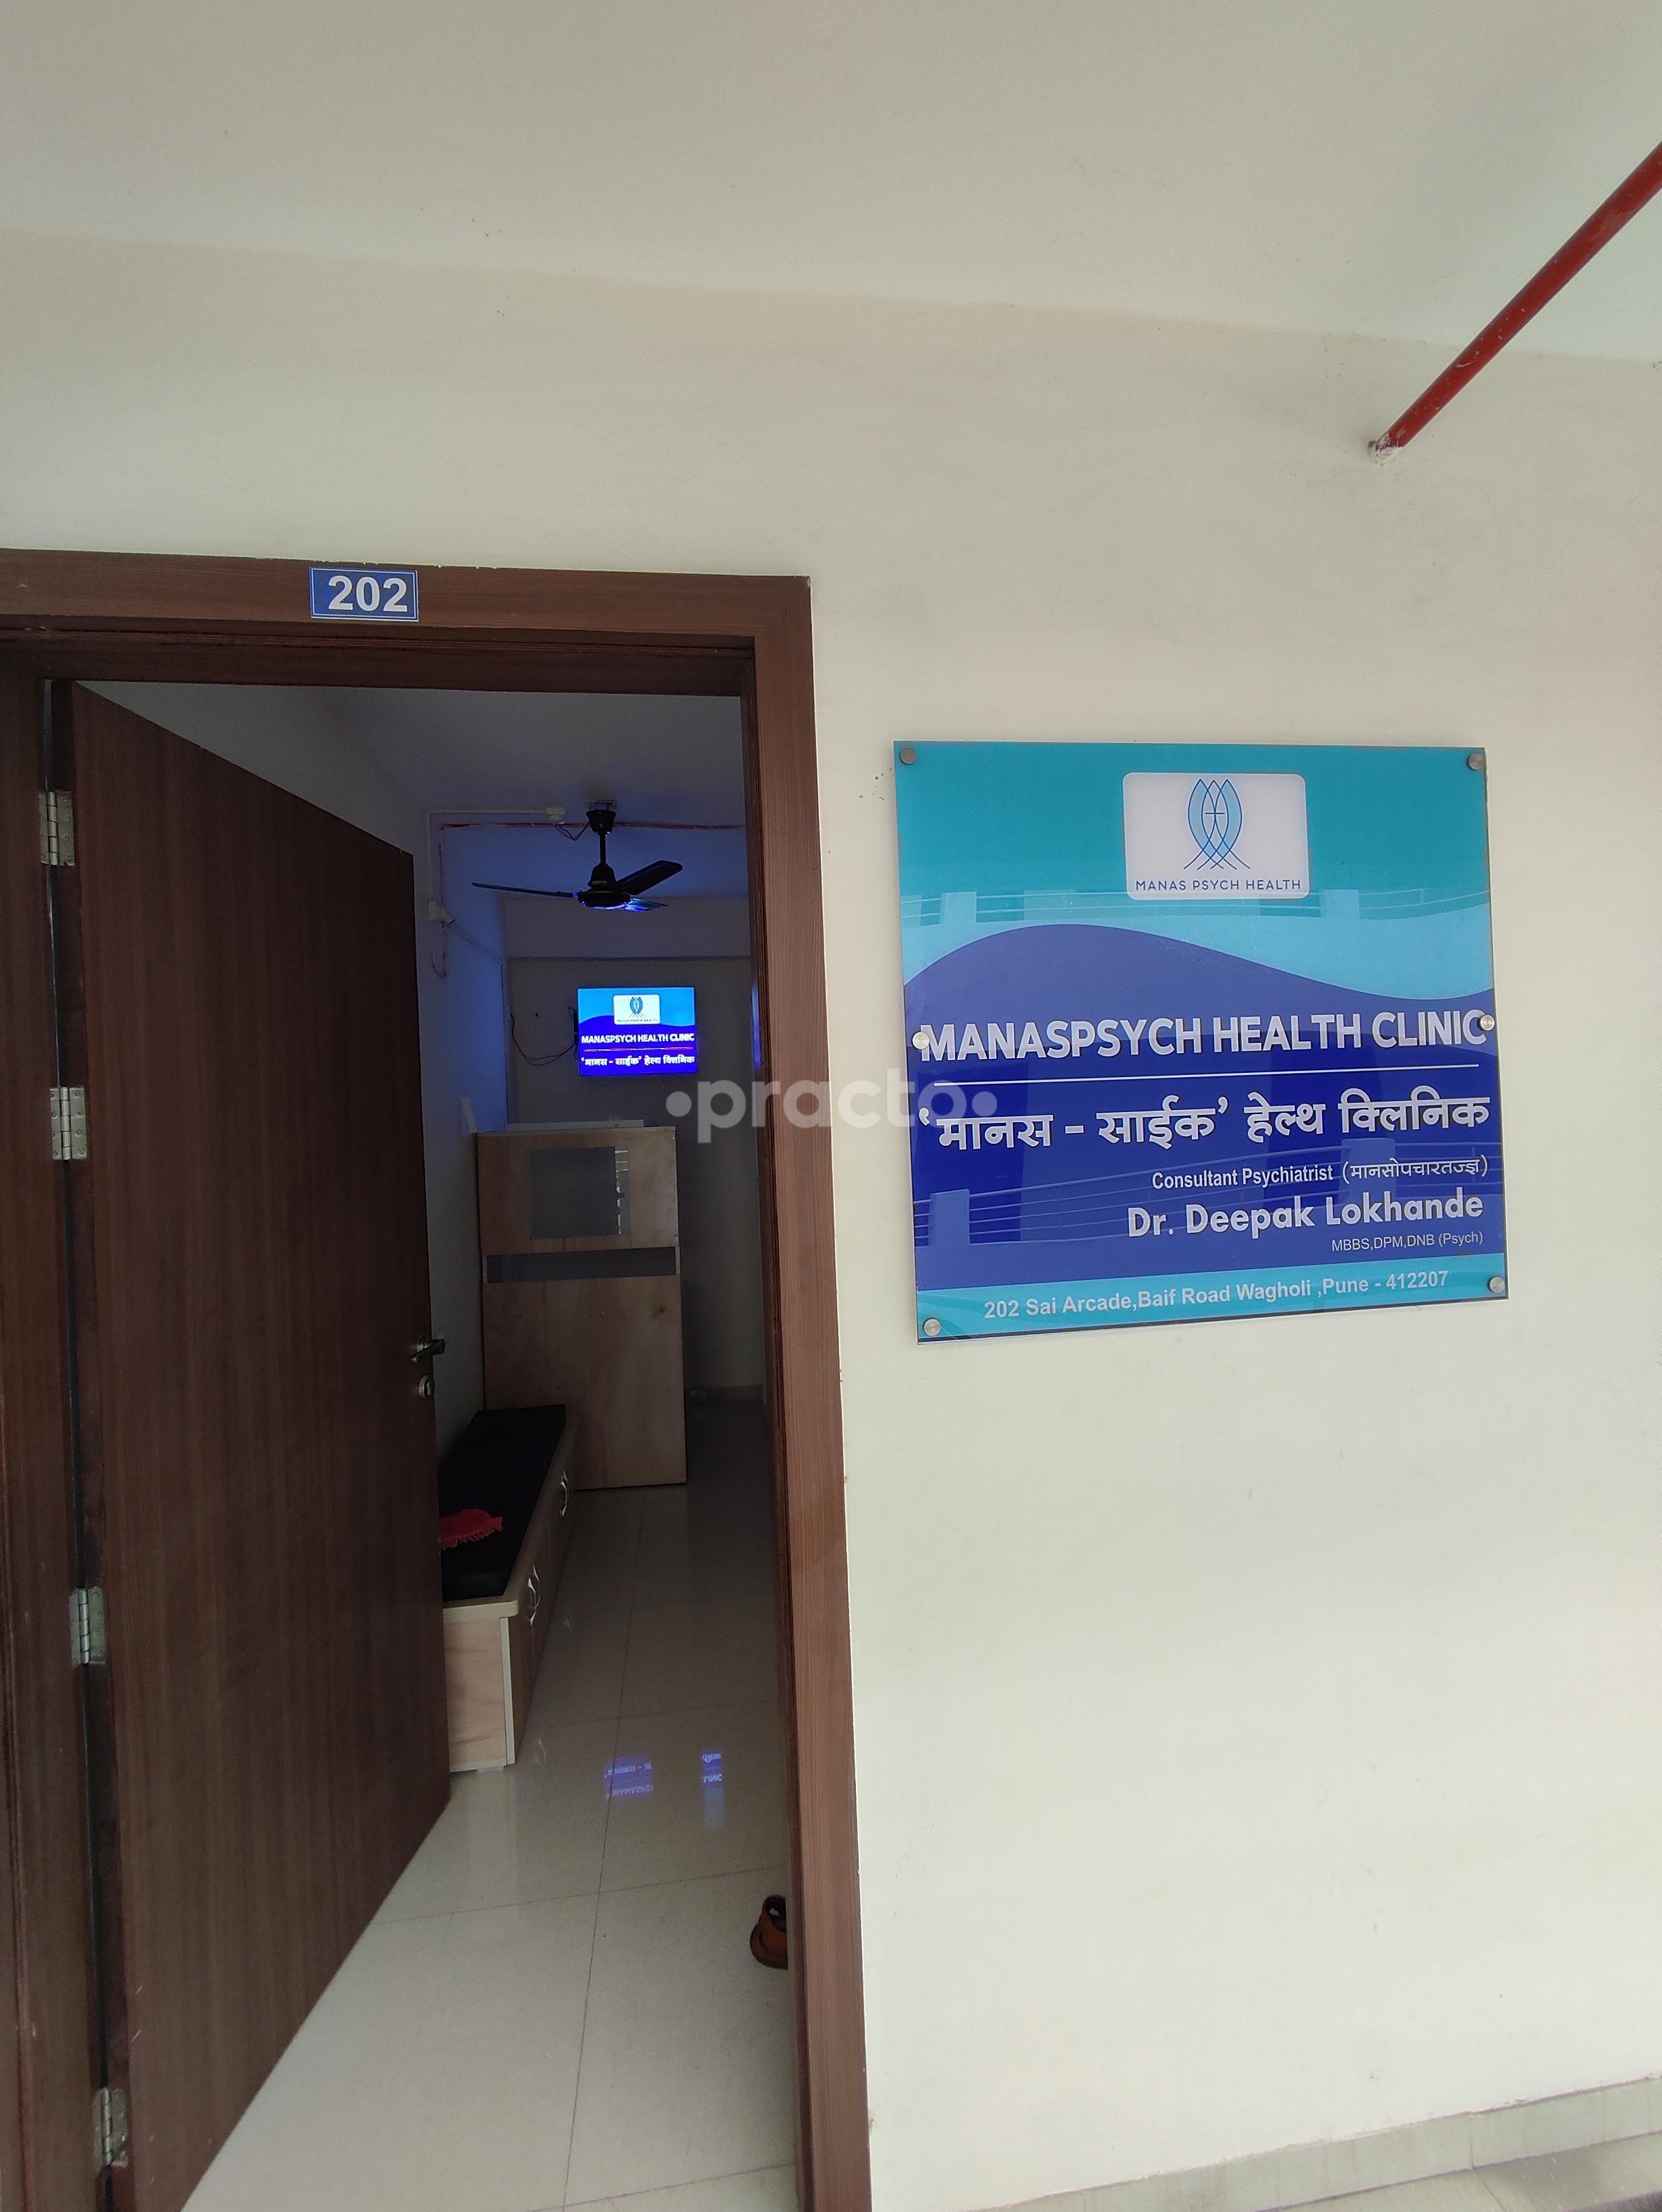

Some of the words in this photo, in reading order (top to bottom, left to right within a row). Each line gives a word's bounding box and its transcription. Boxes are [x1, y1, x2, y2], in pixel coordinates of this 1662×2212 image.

[328, 575, 407, 612] 202
[1136, 880, 1186, 891] MANAS
[1193, 880, 1239, 890] PSYCH
[1246, 879, 1300, 890] HEALTH
[581, 1035, 637, 1044] MANASPSYCH
[637, 1034, 668, 1042] HEALTH
[670, 1033, 695, 1041] CLINIC
[920, 1017, 1202, 1061] MANASPSYCH
[1213, 1013, 1361, 1053] HEALTH
[1372, 1010, 1488, 1049] CLINIC
[1065, 1125, 1084, 1134] -
[1244, 1092, 1326, 1143] हेल्थ
[1338, 1085, 1491, 1133] क्लिनिक
[1152, 1169, 1238, 1190] Consultant
[1242, 1165, 1334, 1188] Psychiatrist
[1128, 1207, 1174, 1237] Dr.
[1186, 1196, 1315, 1239] Deepak
[1325, 1187, 1483, 1225] Lokhande
[1331, 1234, 1435, 1252] MBBS,DPM,DNB
[1439, 1231, 1483, 1247] (Psych)
[984, 1300, 1020, 1318] 202
[1026, 1298, 1056, 1316] Sai
[1182, 1285, 1231, 1304] Road
[1236, 1280, 1311, 1303] Wagholi
[1385, 1271, 1449, 1289] 412207
